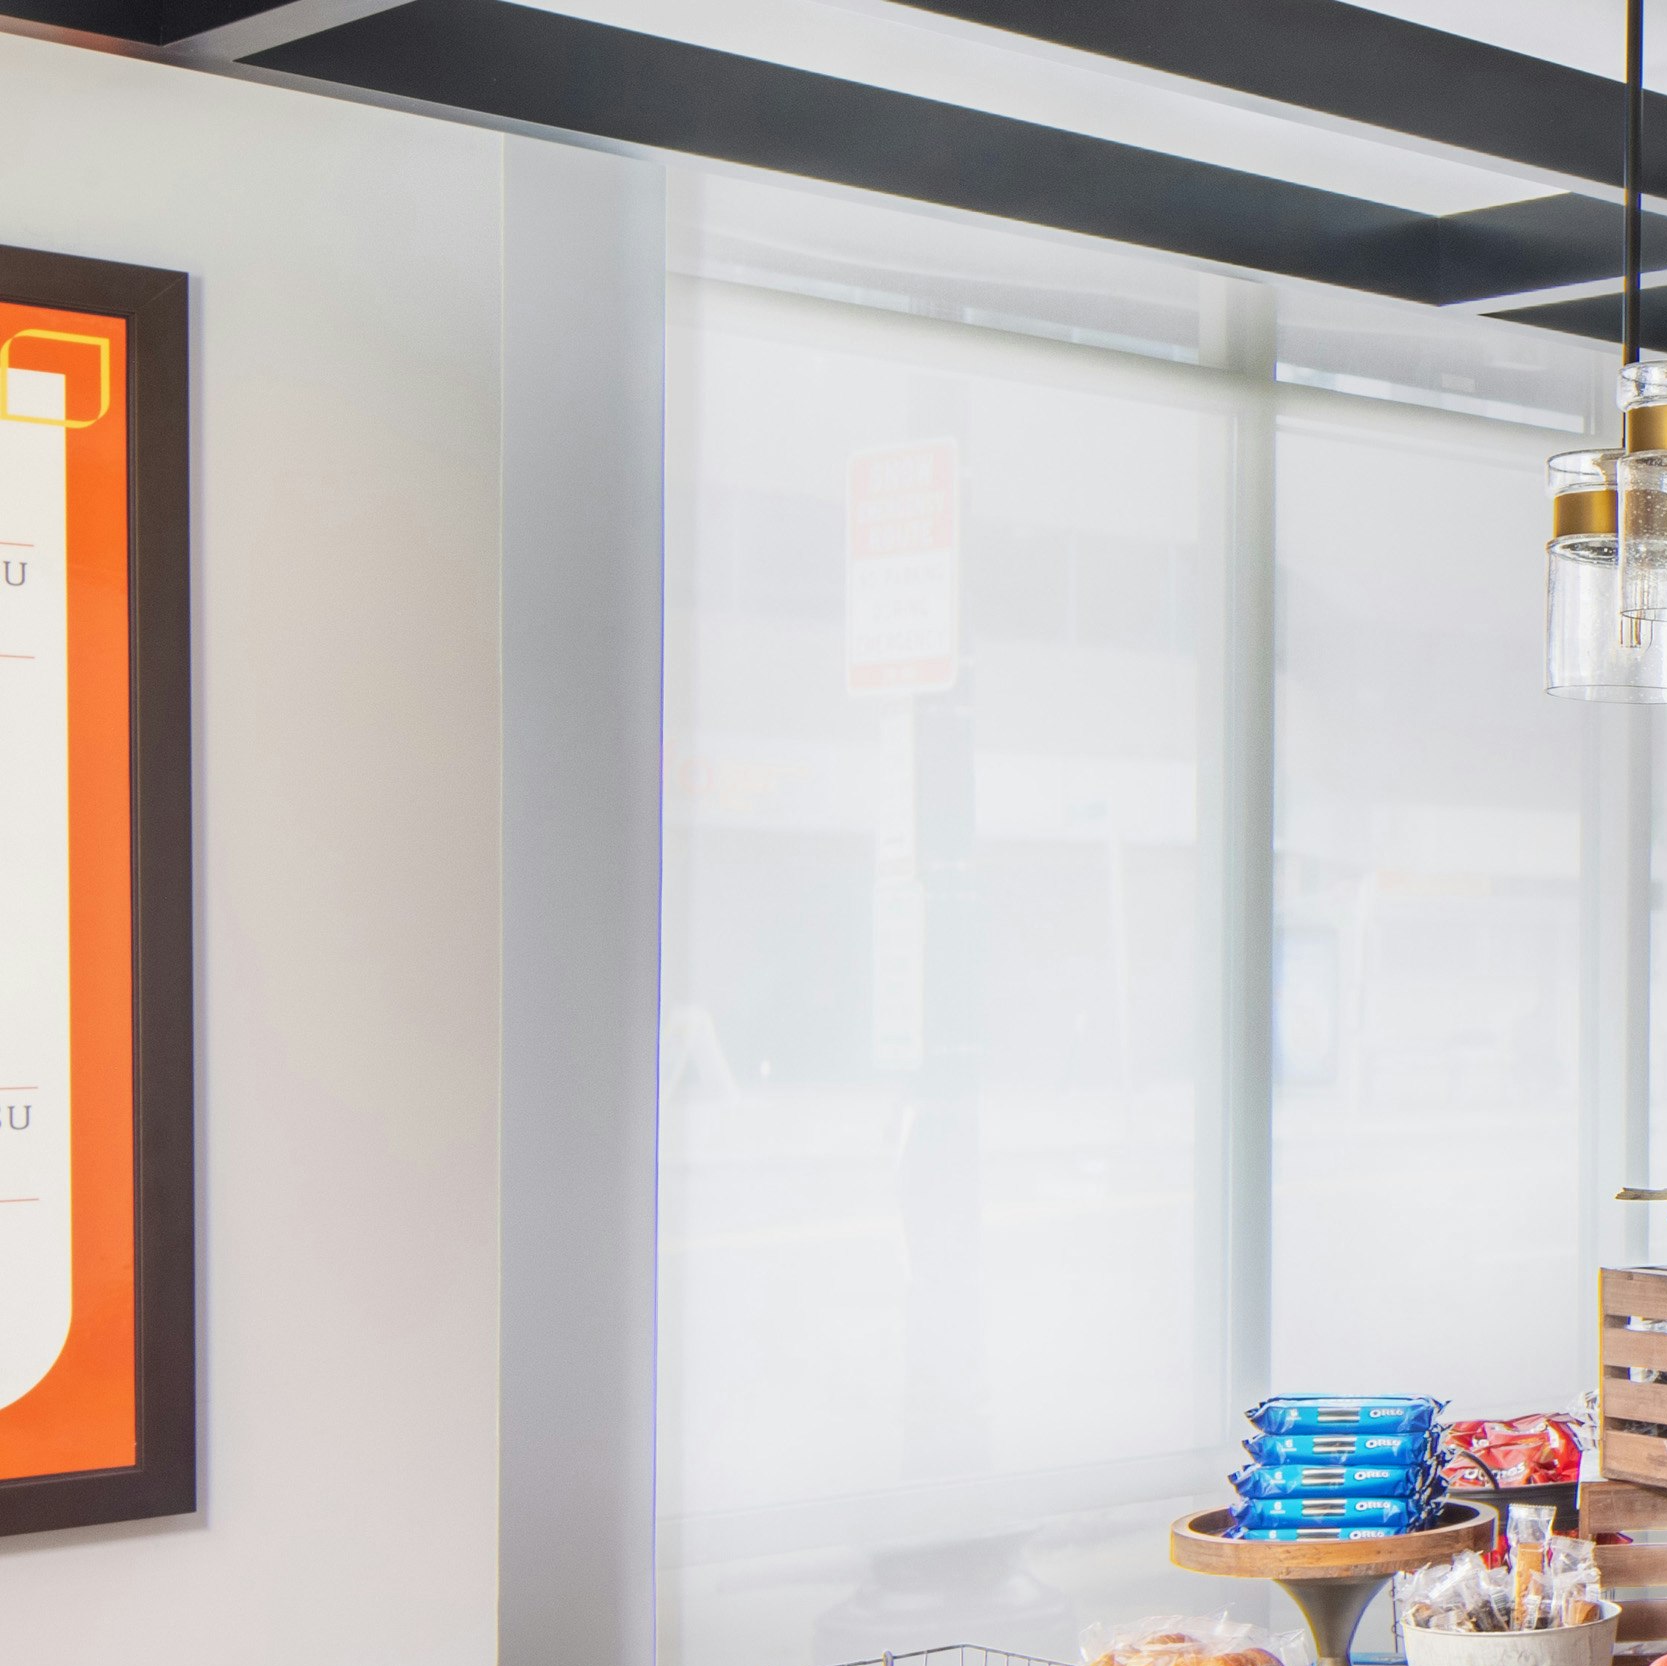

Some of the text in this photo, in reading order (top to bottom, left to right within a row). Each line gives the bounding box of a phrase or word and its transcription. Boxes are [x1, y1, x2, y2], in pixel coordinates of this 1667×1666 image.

[1370, 1409, 1403, 1418] OREO
[1365, 1439, 1401, 1448] OREO
[1354, 1471, 1389, 1481] OREO
[1355, 1502, 1391, 1511] OREO
[1349, 1531, 1385, 1540] OREO
